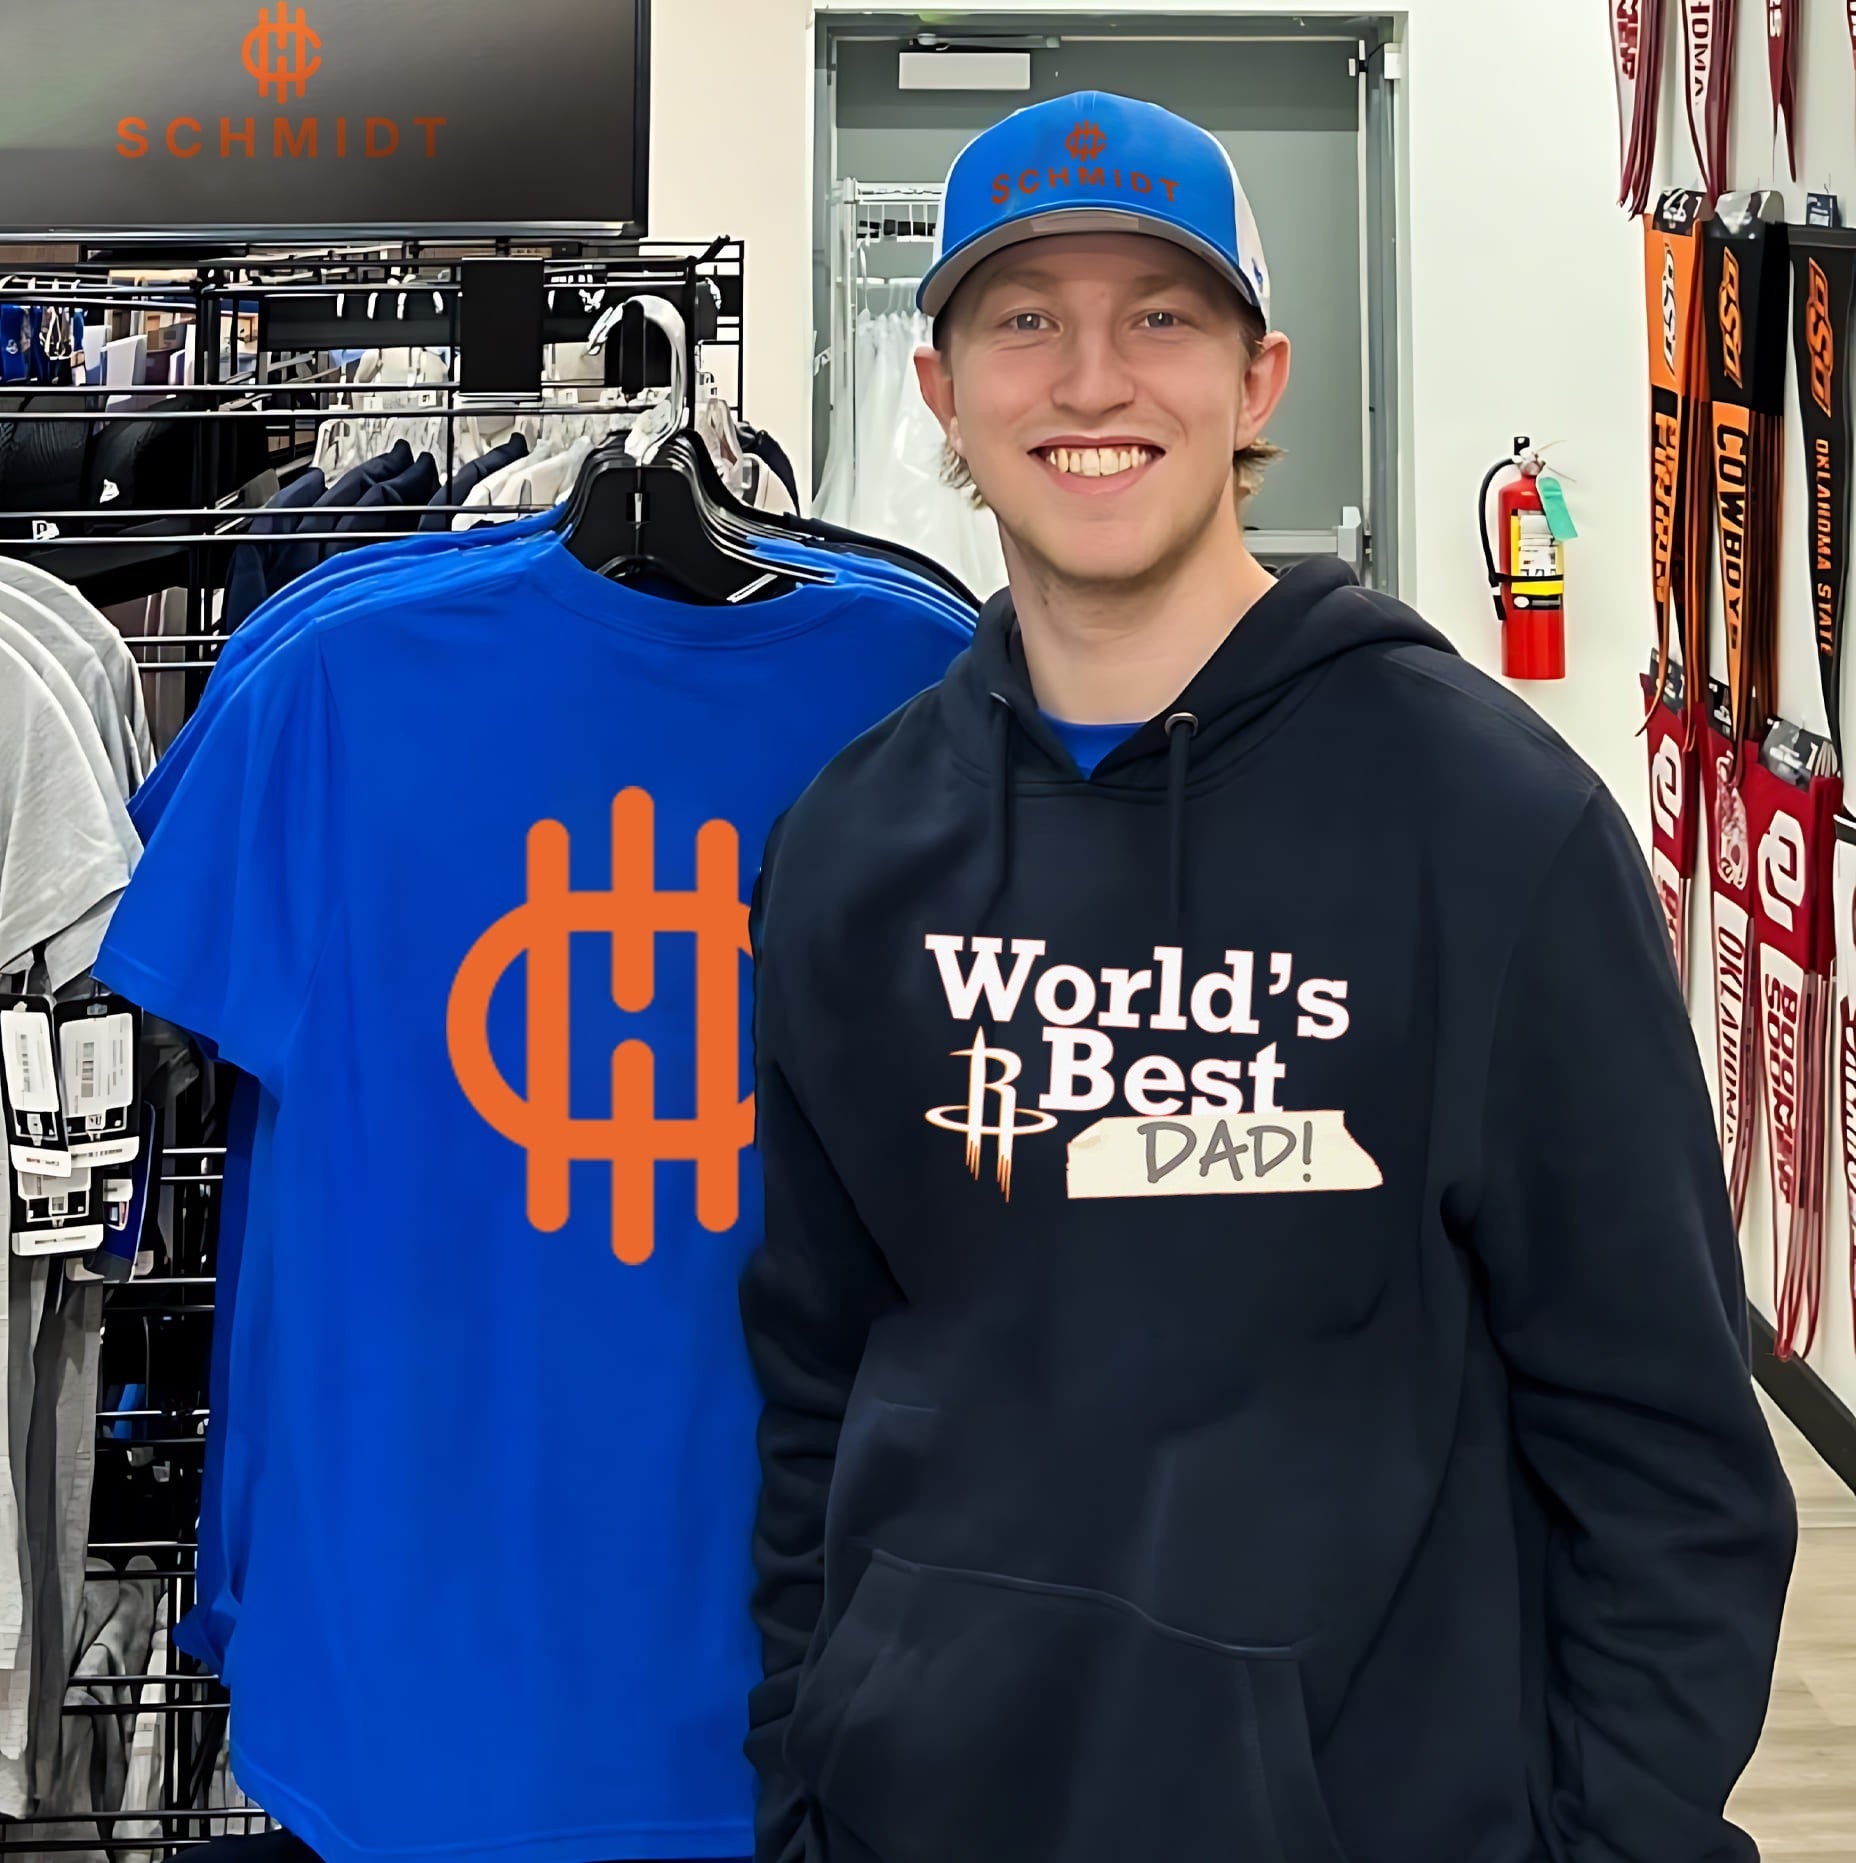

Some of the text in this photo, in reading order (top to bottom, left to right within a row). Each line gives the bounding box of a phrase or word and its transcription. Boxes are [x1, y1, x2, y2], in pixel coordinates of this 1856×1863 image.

[116, 116, 448, 159] SCHMIDT
[991, 167, 1179, 204] SCHMIDT
[1814, 438, 1832, 570] OKLAHOMA
[925, 934, 1350, 1040] World's
[1039, 1026, 1286, 1116] Best
[1137, 1119, 1313, 1183] DAD!
